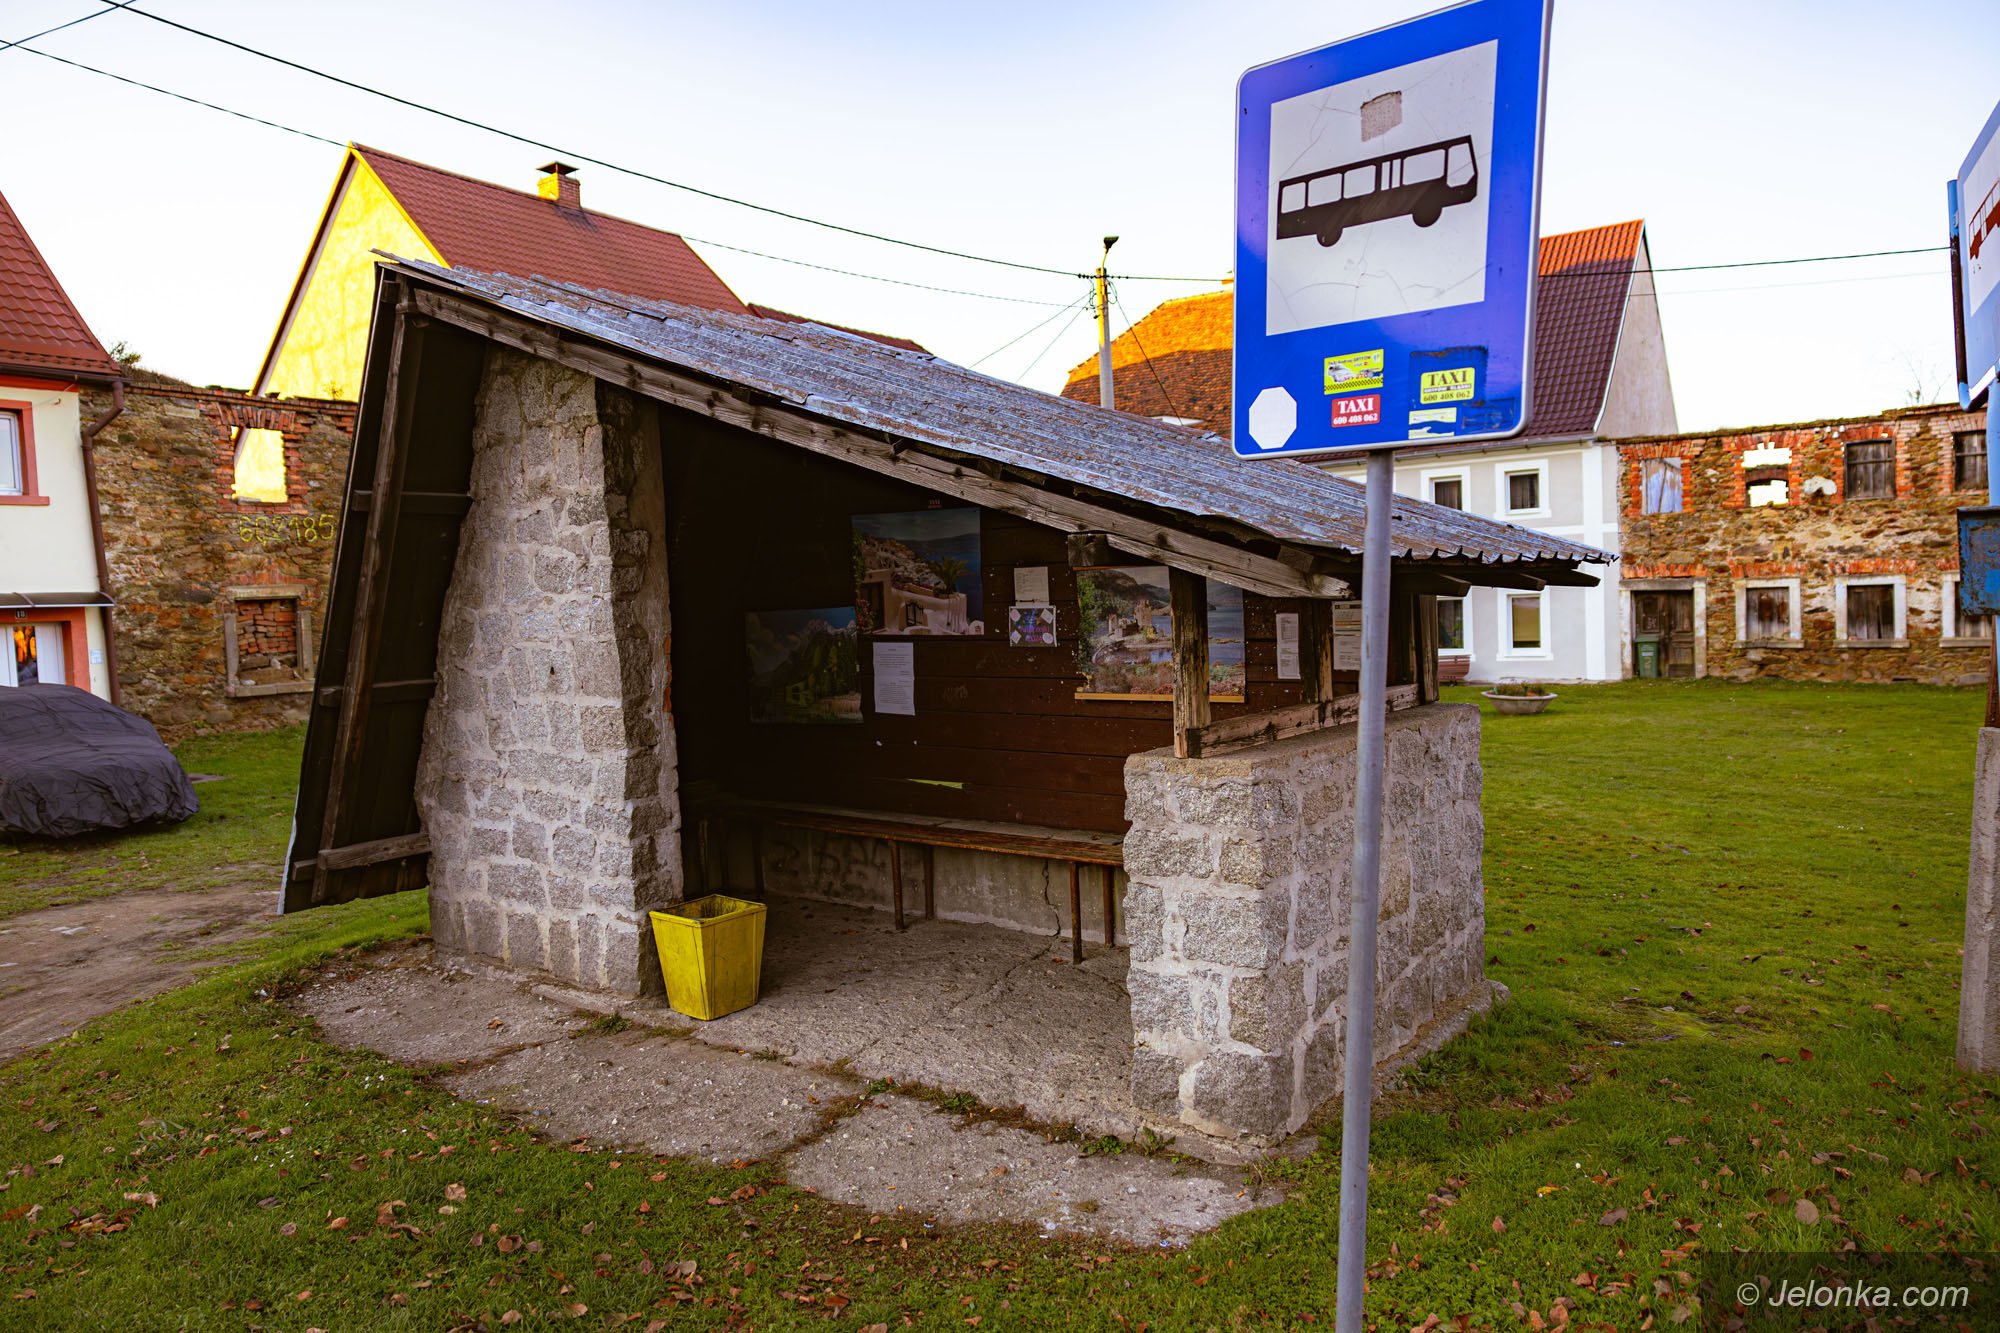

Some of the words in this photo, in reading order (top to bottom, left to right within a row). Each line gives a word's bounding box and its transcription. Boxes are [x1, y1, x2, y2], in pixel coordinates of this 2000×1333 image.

[1427, 370, 1468, 386] TAXI
[1423, 393, 1438, 402] 600
[1440, 391, 1454, 400] 408
[1456, 390, 1471, 399] 062
[1338, 397, 1374, 414] TAXI
[1333, 416, 1347, 425] 600
[1348, 414, 1363, 423] 408
[1363, 412, 1378, 422] 062
